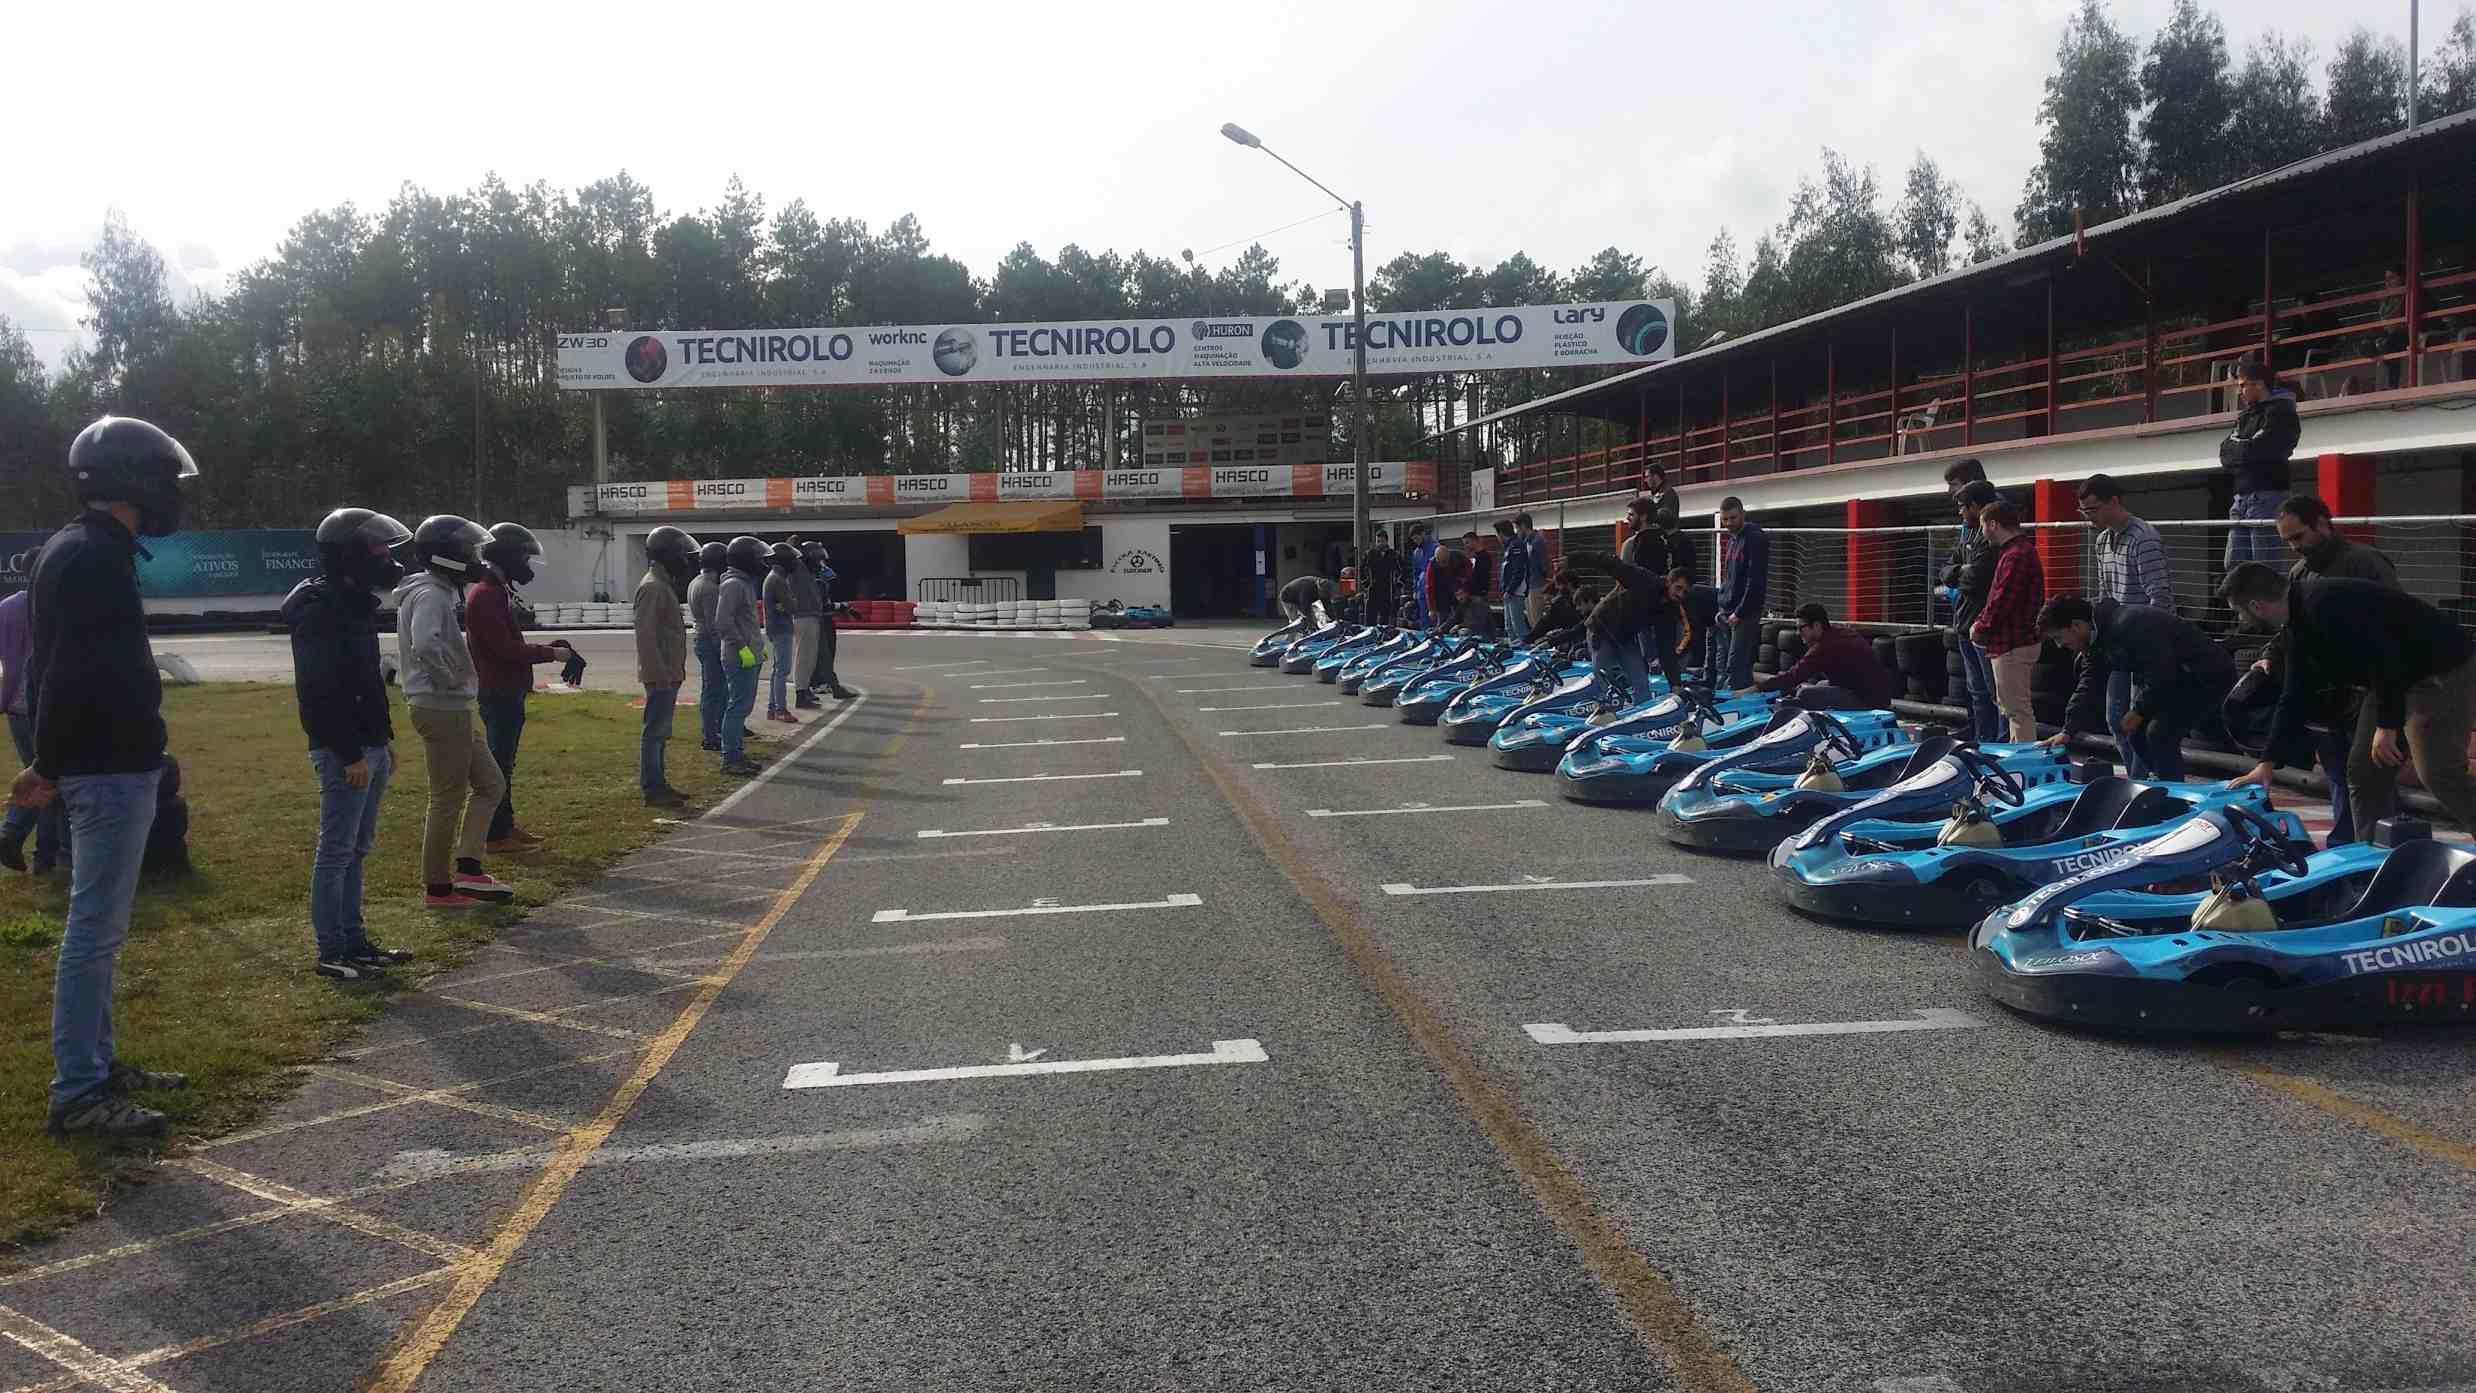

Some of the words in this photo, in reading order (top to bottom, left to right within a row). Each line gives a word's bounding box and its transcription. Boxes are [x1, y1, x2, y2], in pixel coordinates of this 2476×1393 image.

[868, 329, 927, 345] worknc
[1213, 325, 1250, 336] HURON
[989, 325, 1176, 357] TECNIROLO
[677, 334, 853, 365] TECNIROLO
[1001, 475, 1052, 489] HASCO
[1107, 472, 1159, 486] HASCO
[1215, 469, 1268, 484] HASCO
[697, 483, 745, 496] HASCO
[796, 480, 846, 493] HASCO
[898, 478, 948, 491] HASCO
[600, 486, 647, 499] HASCO
[193, 560, 240, 572] ATIVOS
[265, 558, 317, 569] FINANCE
[2341, 934, 2476, 975] TECNIROL
